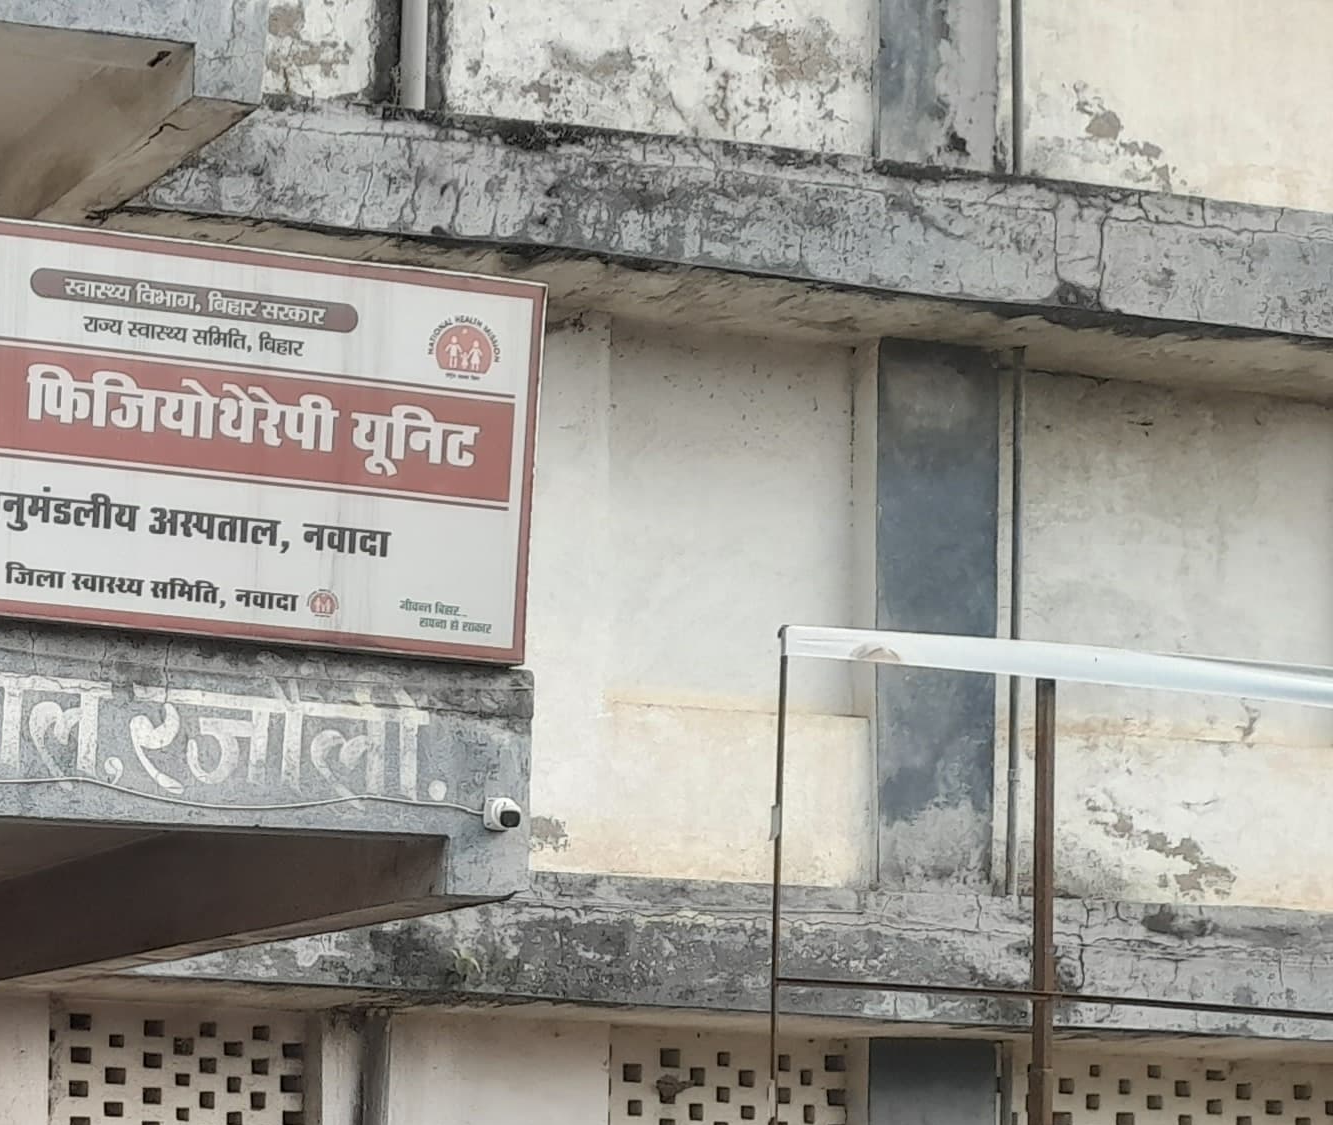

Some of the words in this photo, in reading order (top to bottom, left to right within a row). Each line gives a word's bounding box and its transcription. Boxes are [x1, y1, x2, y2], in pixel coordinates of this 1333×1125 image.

[64, 277, 131, 302] स्वास्थ्य
[136, 283, 202, 313] विभाग,
[208, 291, 258, 317] बिहार
[261, 301, 326, 325] सरकार
[455, 315, 483, 328] HEALTH
[83, 315, 123, 336] राज्य
[128, 320, 186, 343] स्वास्थ्य
[192, 327, 252, 352] समिति,
[258, 331, 305, 356] बिहार
[27, 363, 339, 452] फिजियोथेरेपी
[351, 405, 480, 477] यूनिट
[148, 506, 291, 554] अस्पताल,
[302, 522, 392, 557] नवादा
[5, 561, 65, 589] जिला
[71, 572, 144, 597] स्वास्थ्य
[150, 577, 226, 608] समिति,
[235, 588, 299, 612] नवादा
